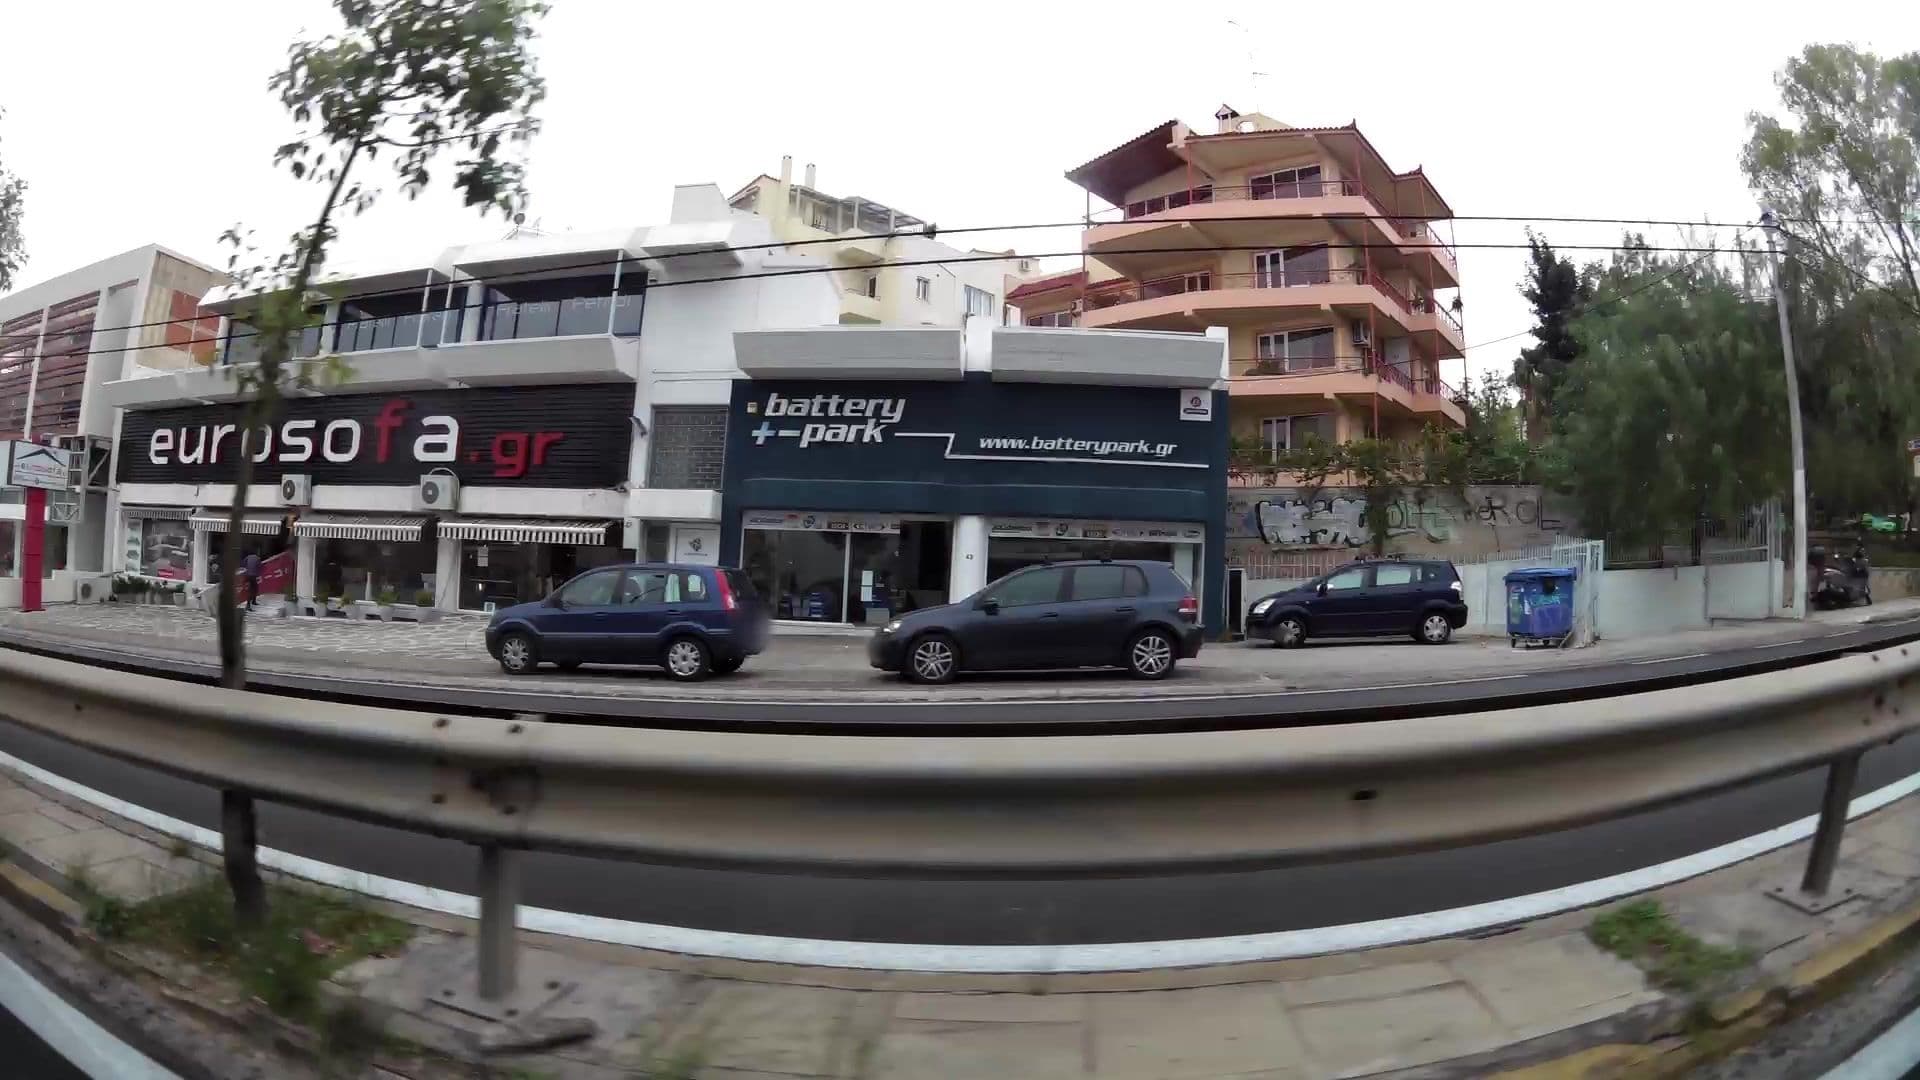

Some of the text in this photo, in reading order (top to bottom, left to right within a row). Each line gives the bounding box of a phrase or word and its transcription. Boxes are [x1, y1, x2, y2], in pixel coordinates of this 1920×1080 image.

[765, 393, 906, 423] battery
[150, 398, 564, 477] eurosofa.gr
[979, 436, 1178, 457] www.batterypark.gr
